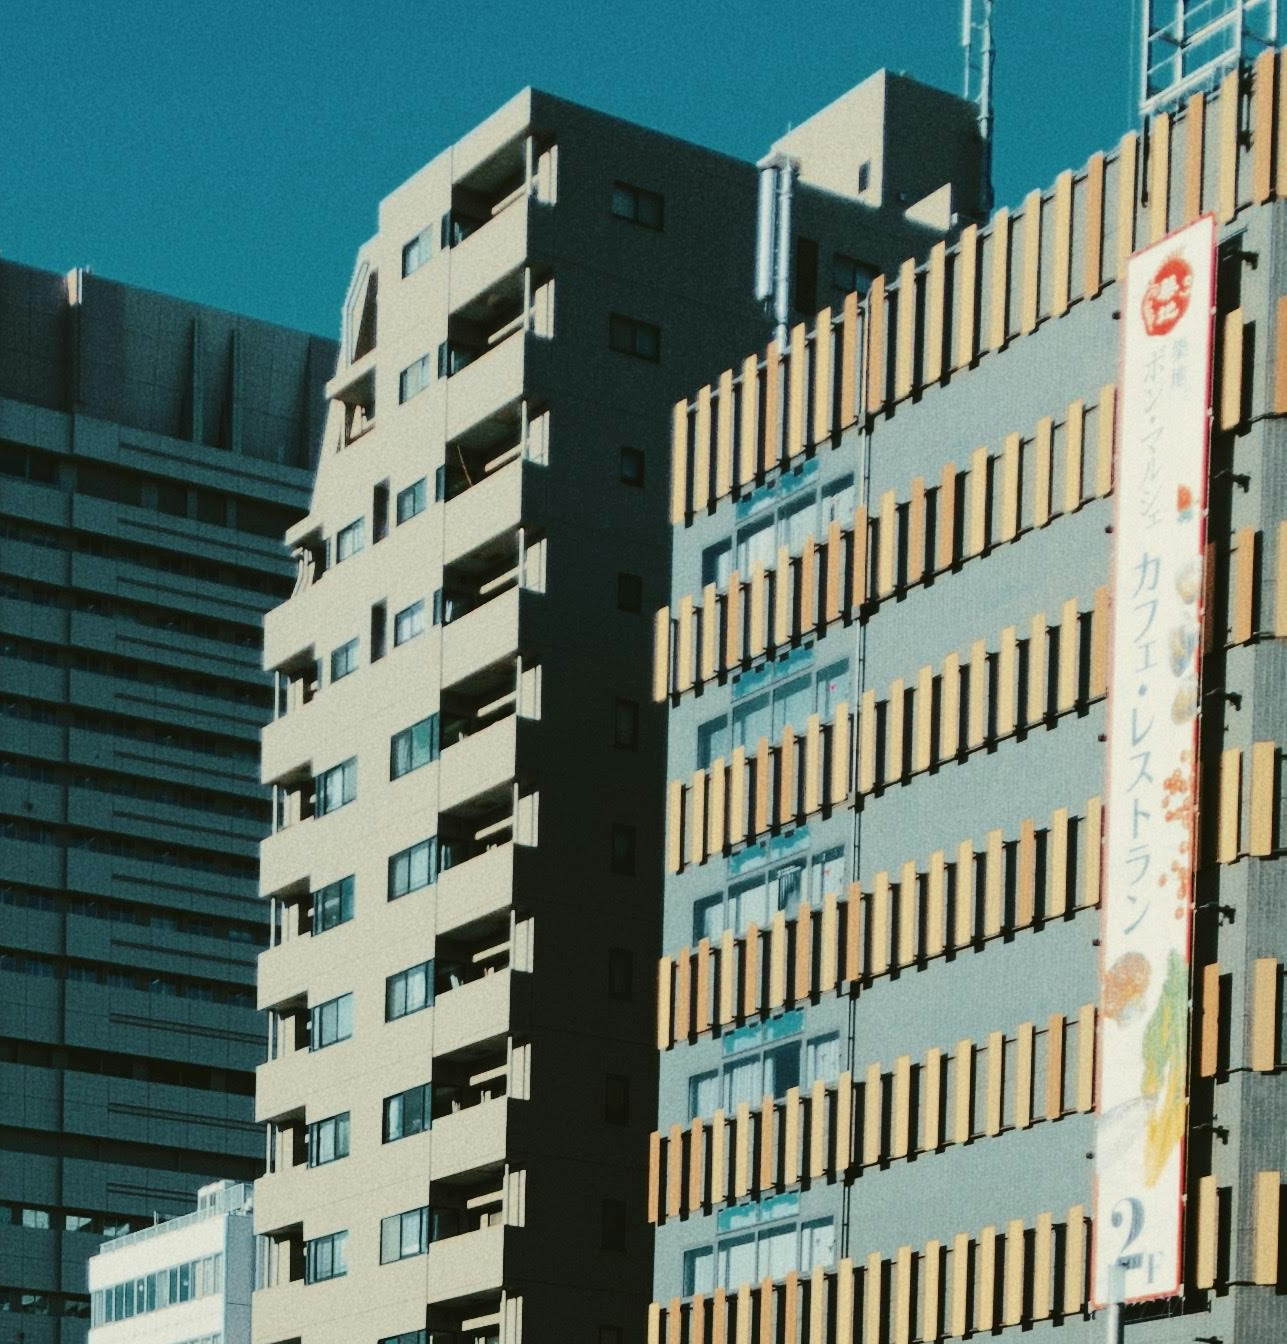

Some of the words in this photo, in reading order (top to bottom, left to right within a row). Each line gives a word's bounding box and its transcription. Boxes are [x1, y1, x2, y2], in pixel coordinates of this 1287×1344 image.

[1123, 552, 1161, 936] カフェ・レストラン
